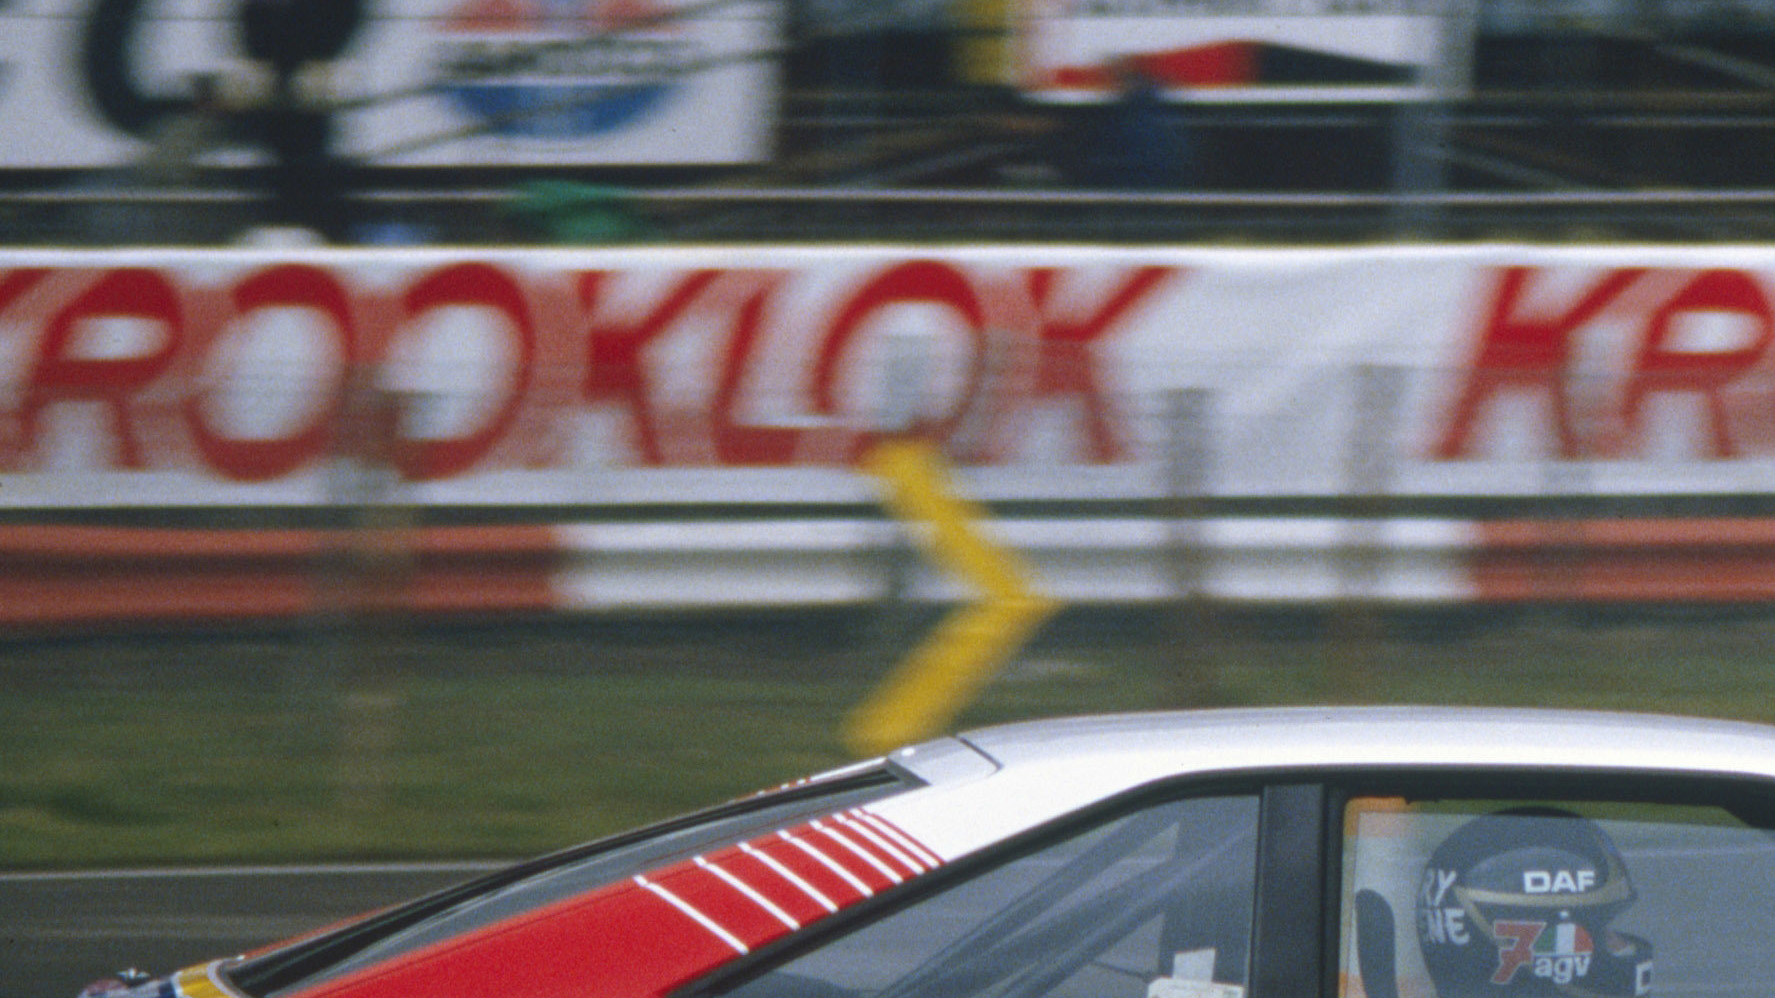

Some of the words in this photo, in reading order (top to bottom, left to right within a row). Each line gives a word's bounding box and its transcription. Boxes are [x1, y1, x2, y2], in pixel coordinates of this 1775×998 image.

[0, 260, 1172, 482] ROOKLOK
[1523, 870, 1595, 893] DAF
[1490, 919, 1547, 985] 7
[1534, 954, 1592, 984] agv
